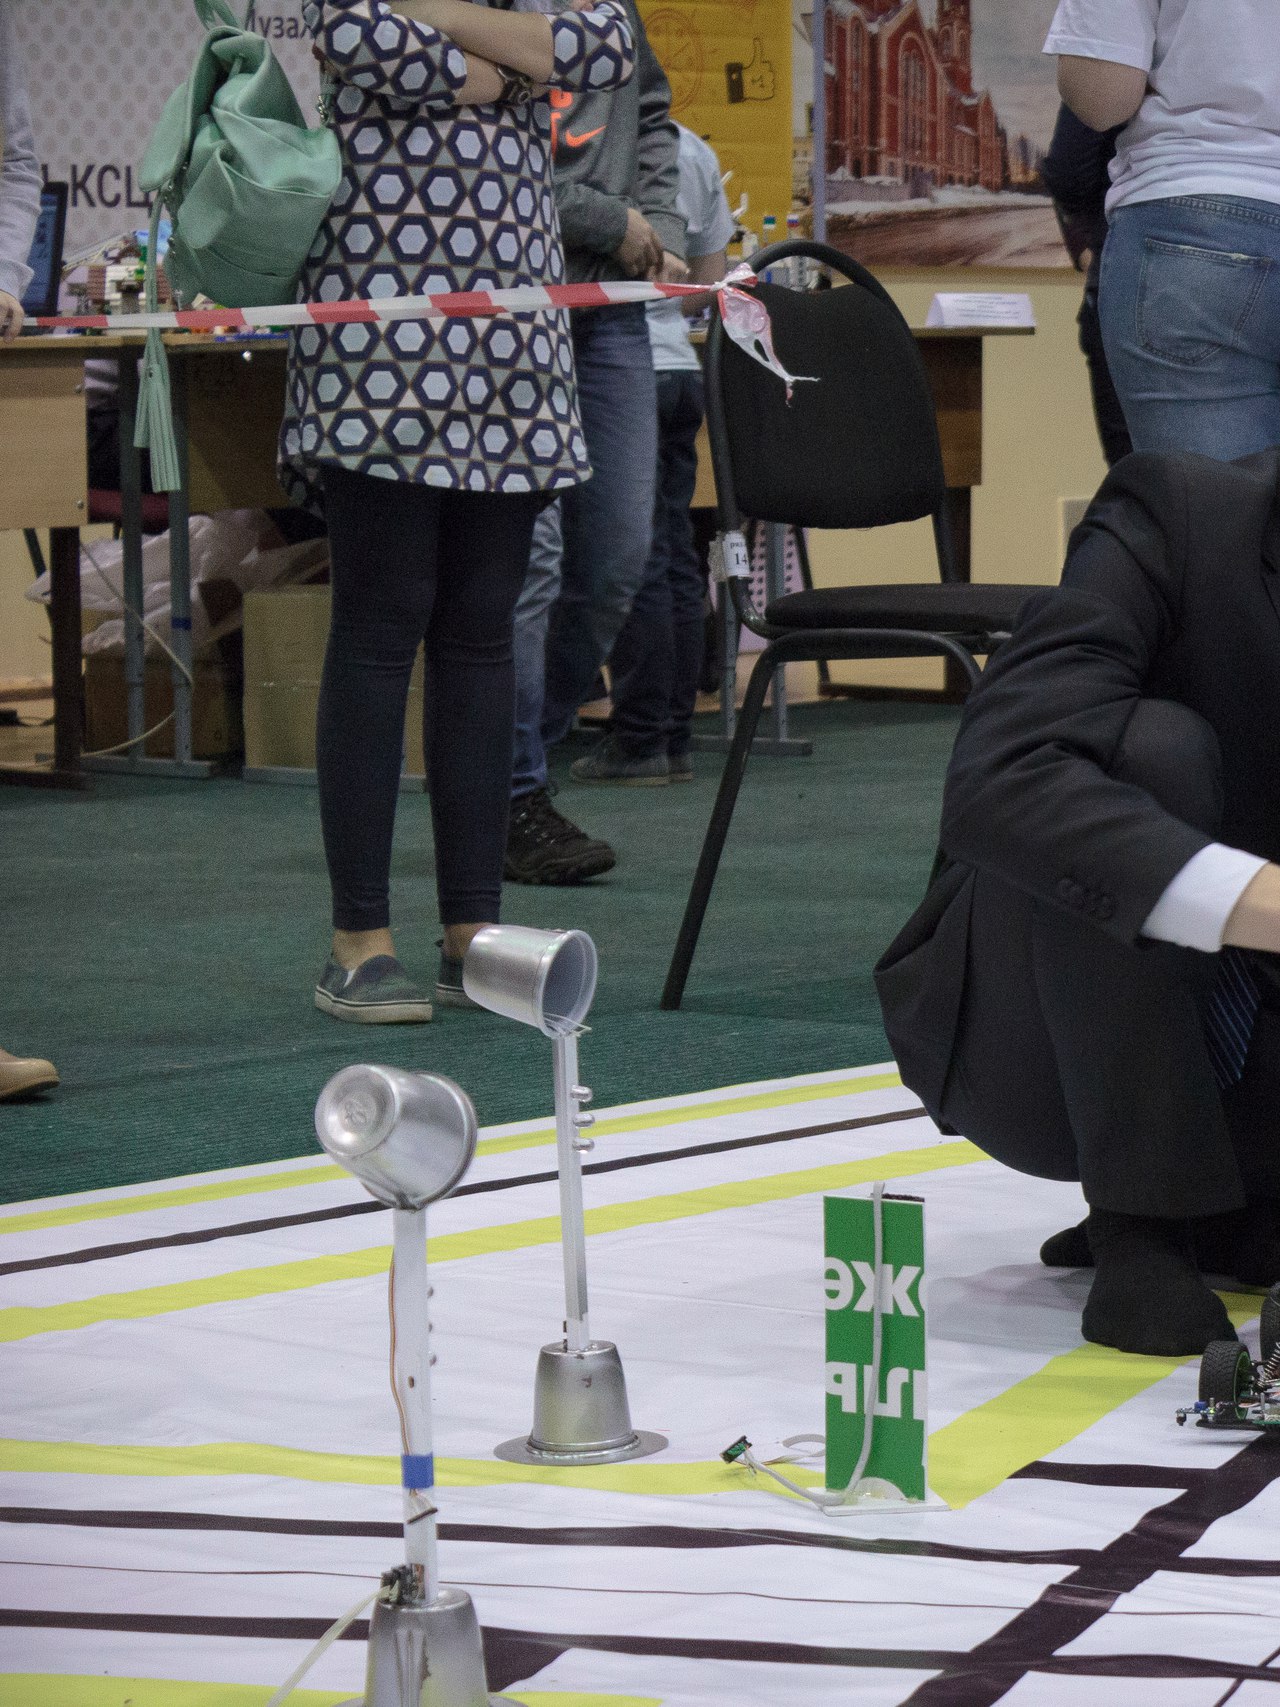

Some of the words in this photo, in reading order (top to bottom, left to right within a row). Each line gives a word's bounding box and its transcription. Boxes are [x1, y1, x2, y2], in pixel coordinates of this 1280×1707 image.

[245, 8, 308, 39] Луза
[734, 552, 748, 565] 14
[824, 1257, 925, 1317] же
